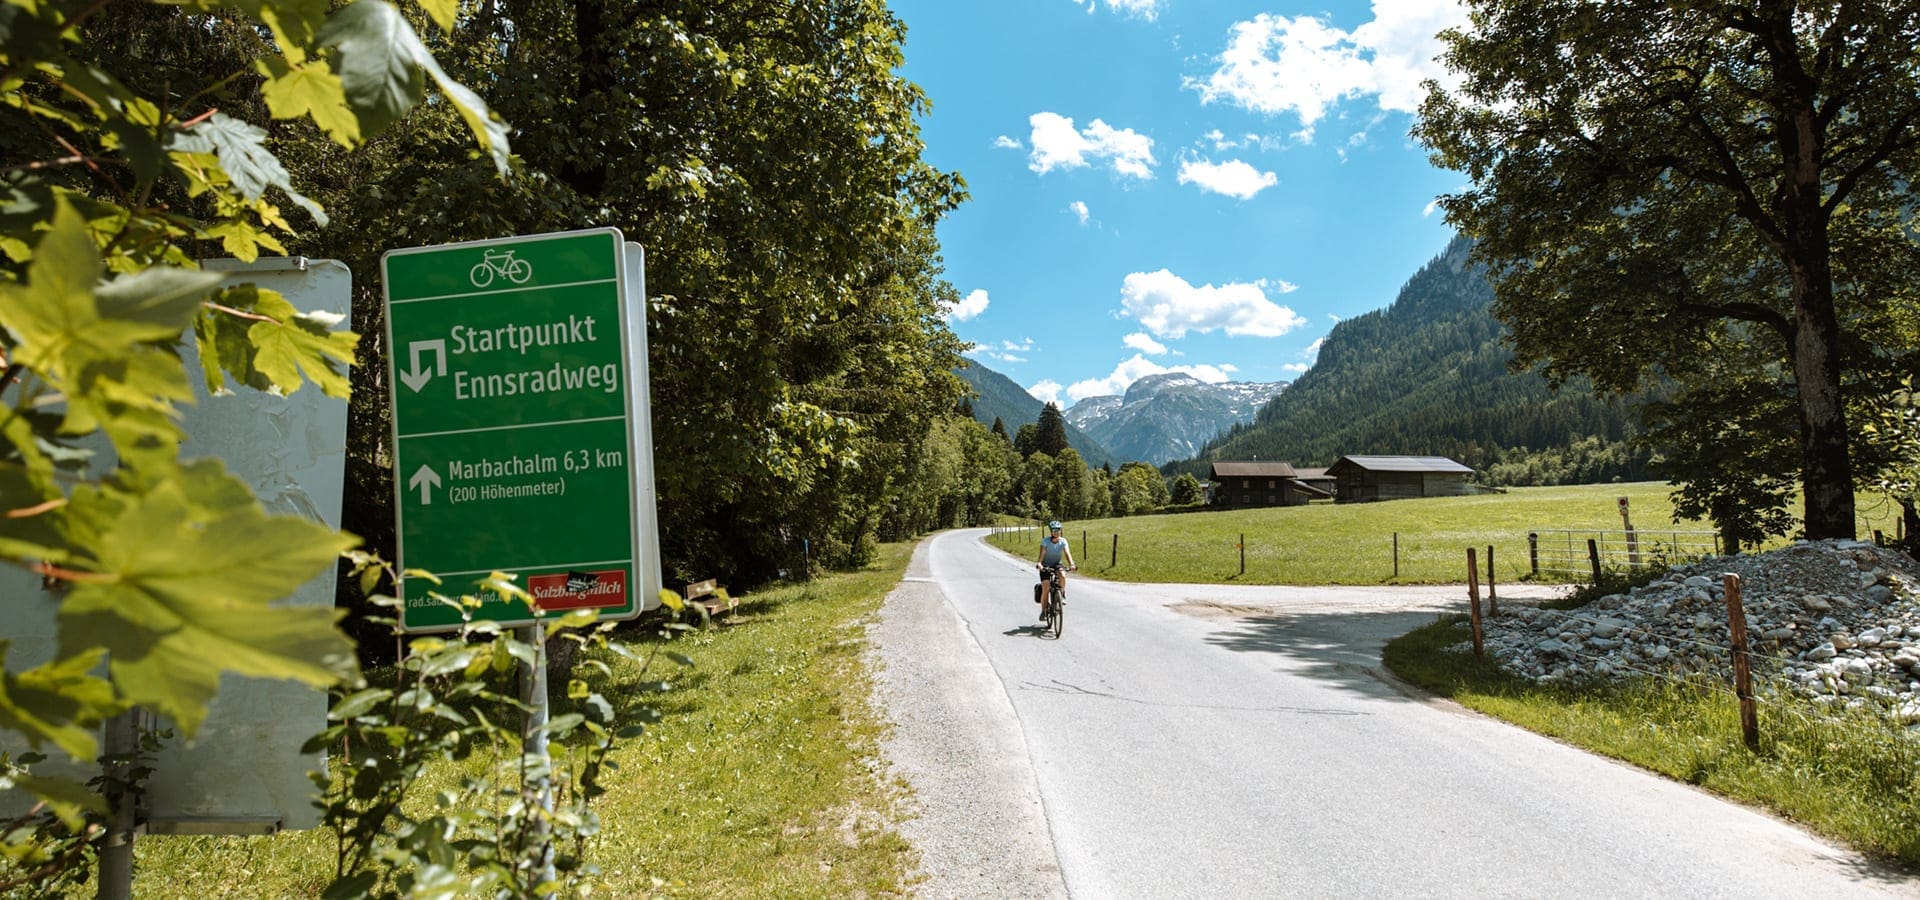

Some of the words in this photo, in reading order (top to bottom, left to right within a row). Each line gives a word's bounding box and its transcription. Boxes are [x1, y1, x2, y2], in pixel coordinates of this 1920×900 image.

[451, 314, 597, 355] Startpunkt
[454, 362, 618, 400] Ennsradweg
[449, 454, 558, 480] Marbachalm
[564, 449, 589, 473] 6,3
[596, 449, 623, 468] km
[449, 486, 477, 504] (200
[481, 477, 565, 500] Höhenmeter)
[534, 581, 621, 600] Salzbgmilch
